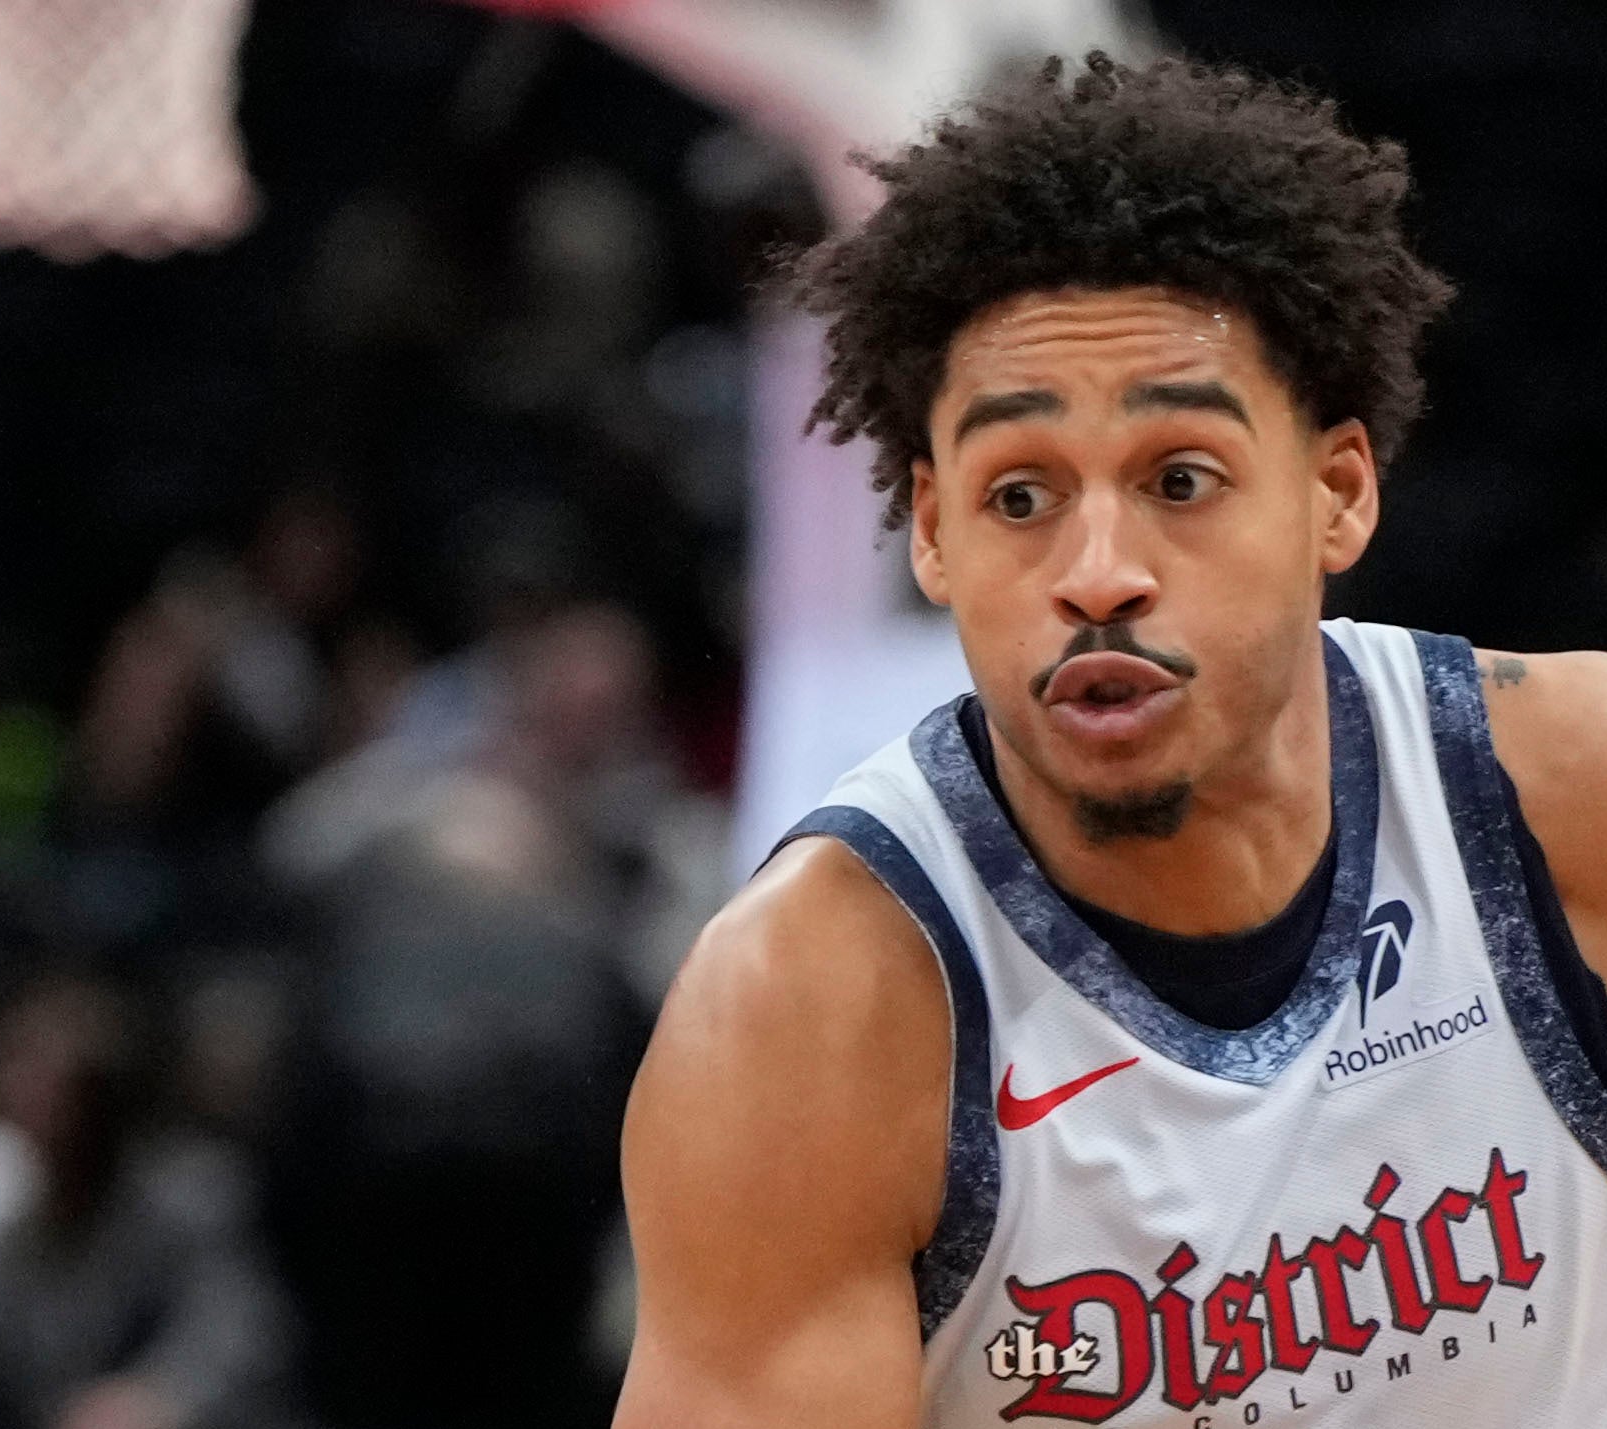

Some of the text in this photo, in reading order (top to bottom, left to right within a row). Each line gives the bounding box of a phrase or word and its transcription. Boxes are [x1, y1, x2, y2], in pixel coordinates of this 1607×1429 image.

[1325, 995, 1488, 1081] Robinhood
[985, 1147, 1545, 1424] the District
